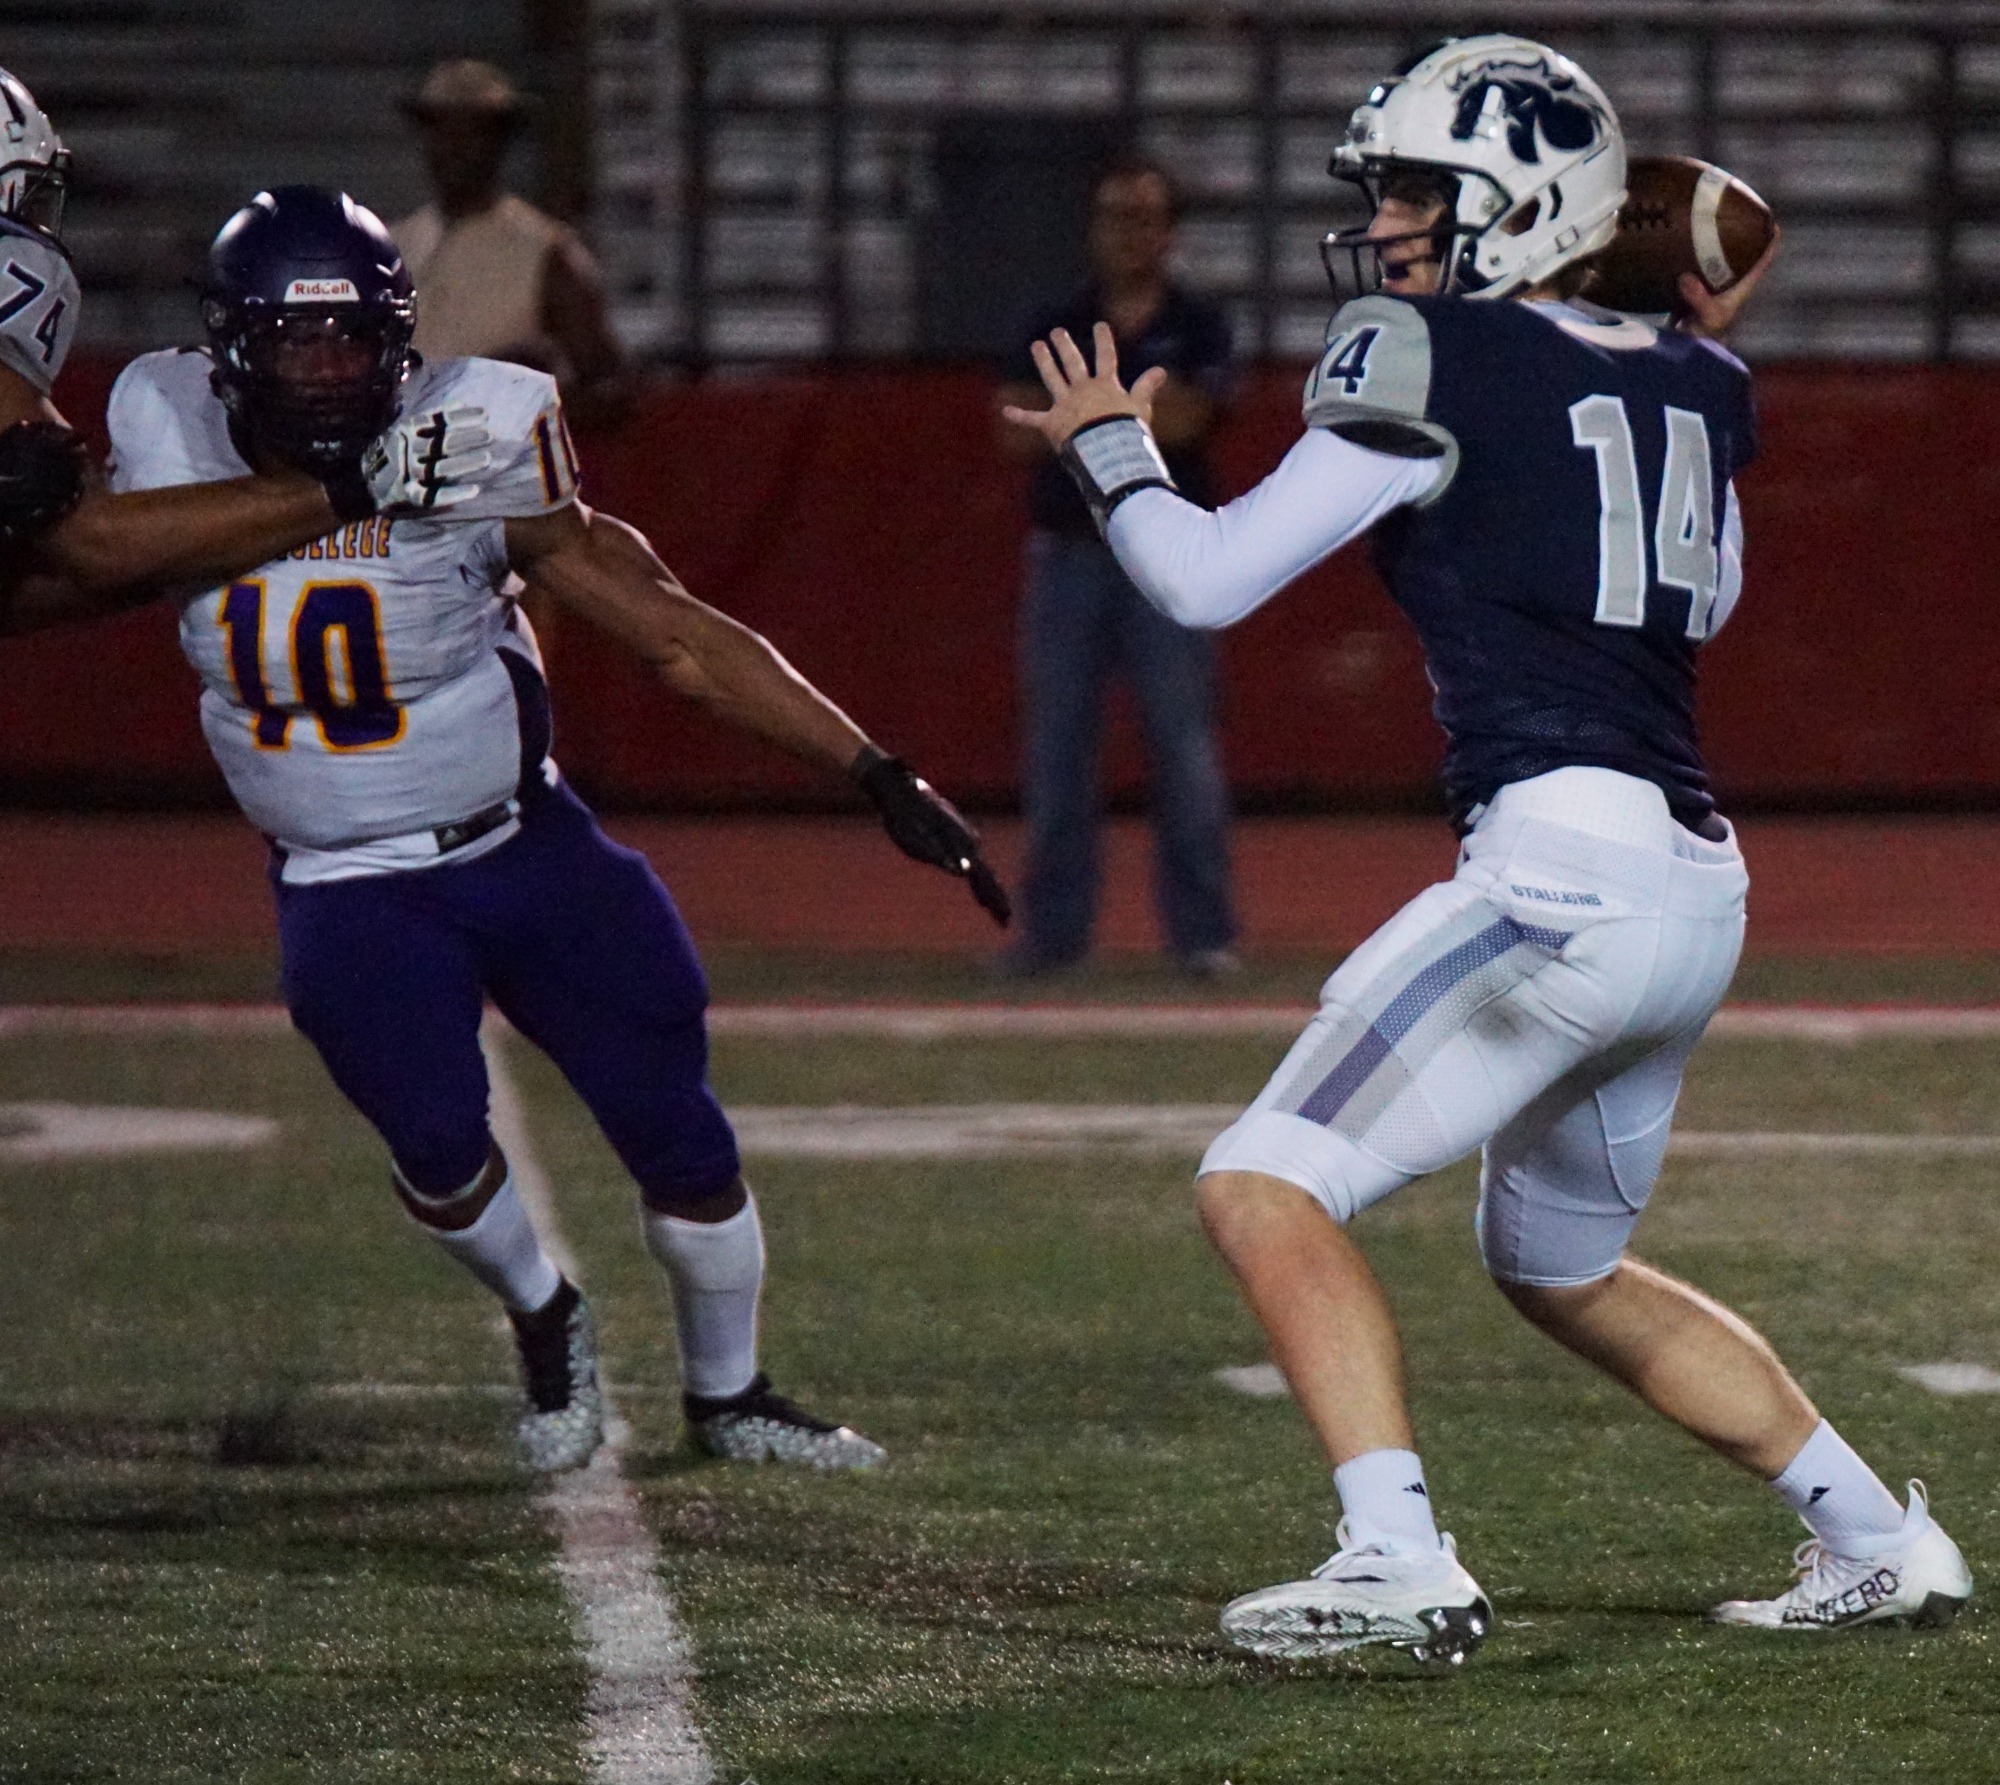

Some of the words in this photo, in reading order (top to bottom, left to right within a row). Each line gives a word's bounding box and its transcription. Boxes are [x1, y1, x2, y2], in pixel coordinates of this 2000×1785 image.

[0, 257, 66, 364] 74
[1568, 394, 1718, 639] 14
[215, 578, 408, 754] 10
